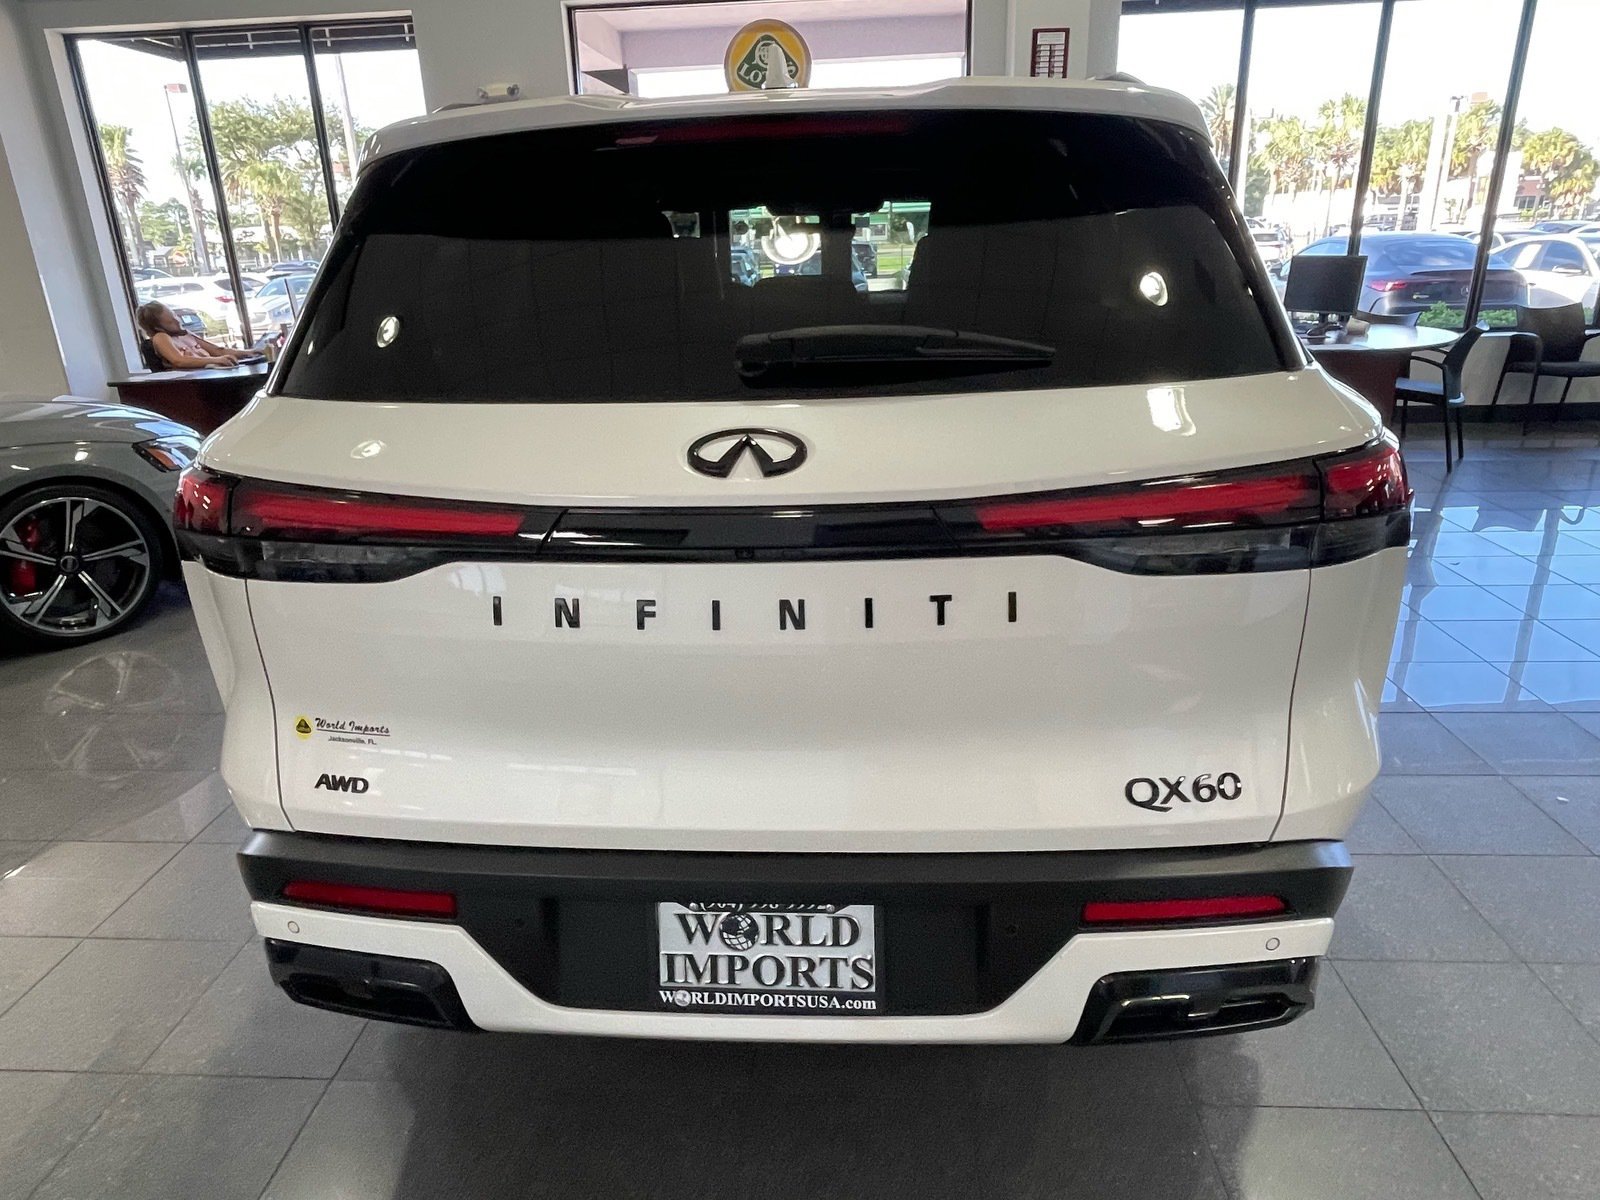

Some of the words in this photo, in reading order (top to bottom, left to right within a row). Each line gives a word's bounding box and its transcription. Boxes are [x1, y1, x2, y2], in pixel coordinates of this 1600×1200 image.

[738, 61, 797, 84] LOS
[492, 591, 1018, 631] INFINITI
[315, 717, 346, 731] World
[349, 720, 390, 734] Imports
[314, 773, 369, 794] AWD
[1124, 772, 1242, 812] QX60
[661, 952, 875, 990] IMPORTS
